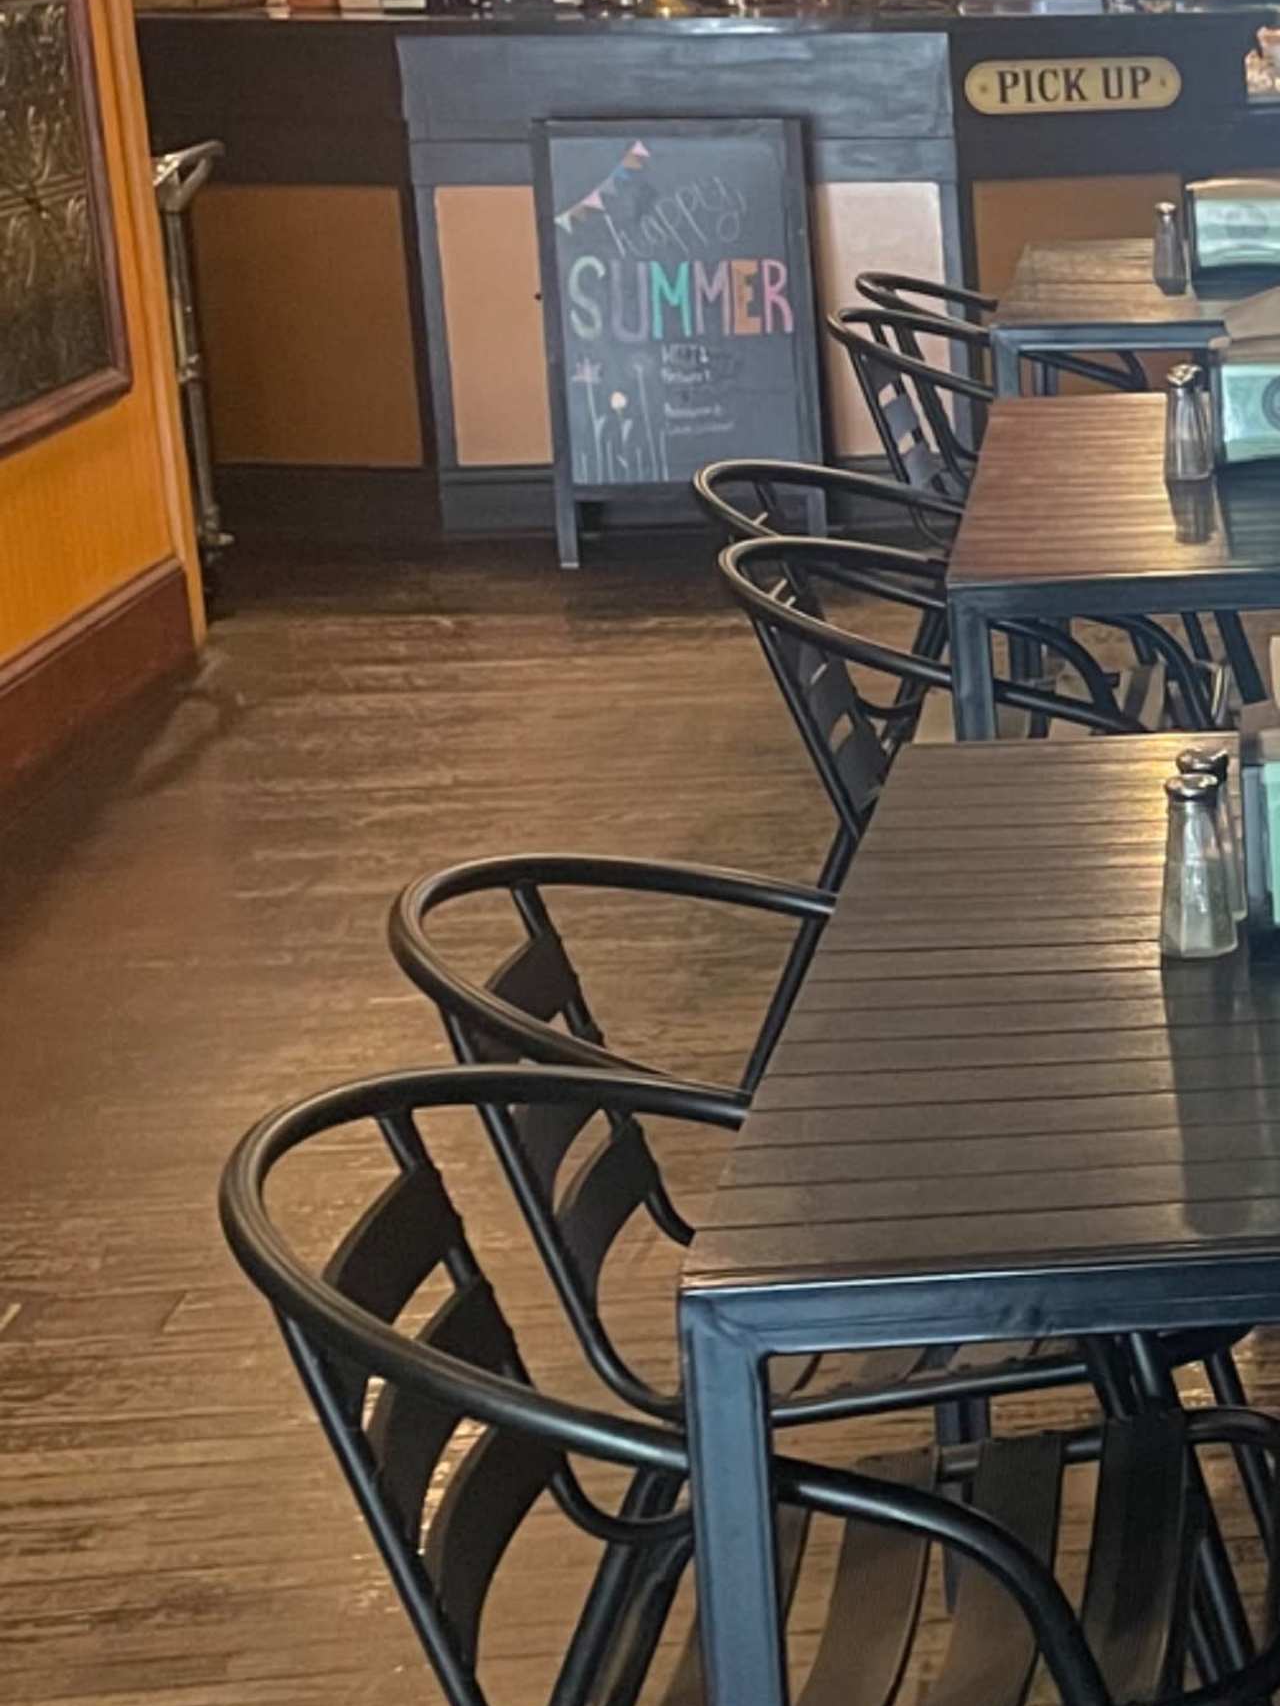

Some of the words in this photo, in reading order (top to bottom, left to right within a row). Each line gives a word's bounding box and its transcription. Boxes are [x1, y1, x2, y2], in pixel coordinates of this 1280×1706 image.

[997, 67, 1088, 104] PICK
[1101, 65, 1152, 100] UP
[568, 255, 794, 342] SUMMER
